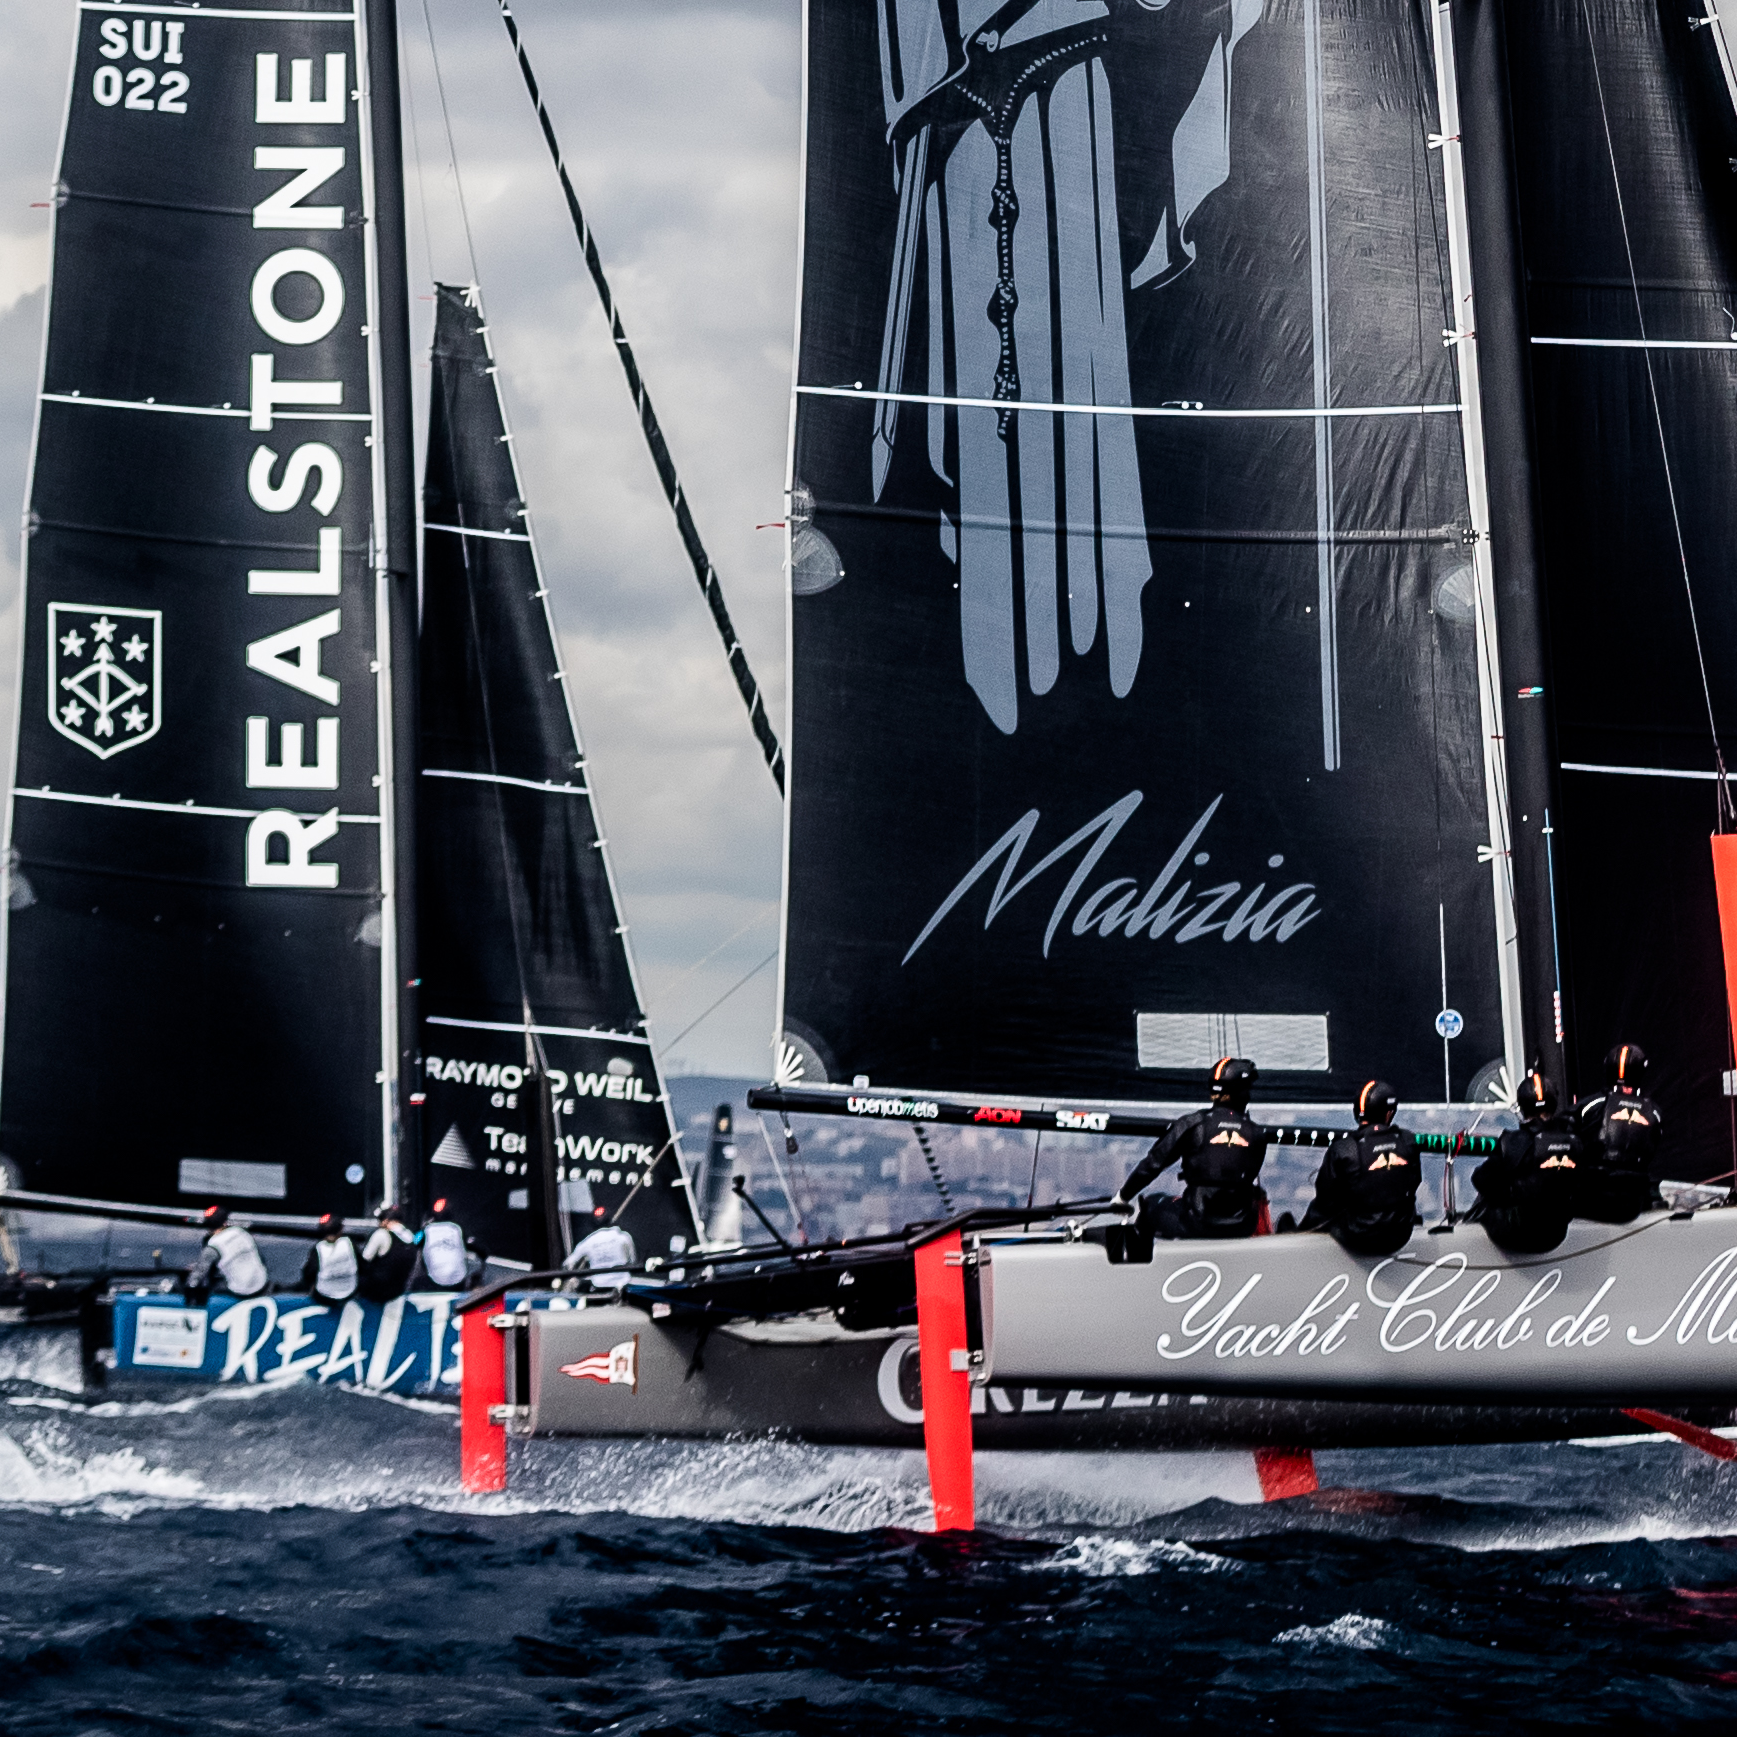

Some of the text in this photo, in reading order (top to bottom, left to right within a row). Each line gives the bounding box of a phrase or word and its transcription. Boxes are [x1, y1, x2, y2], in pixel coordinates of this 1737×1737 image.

[98, 17, 185, 65] SUI
[92, 65, 191, 115] 022
[244, 51, 347, 889] REALSTONE
[901, 789, 1322, 966] Malizia
[425, 1056, 654, 1104] RAYMOD WEIL
[974, 1106, 1022, 1125] AON
[210, 1292, 463, 1393] REALT
[1157, 1260, 1360, 1361] Yacht
[1365, 1251, 1563, 1354] Club
[1546, 1275, 1618, 1349] de
